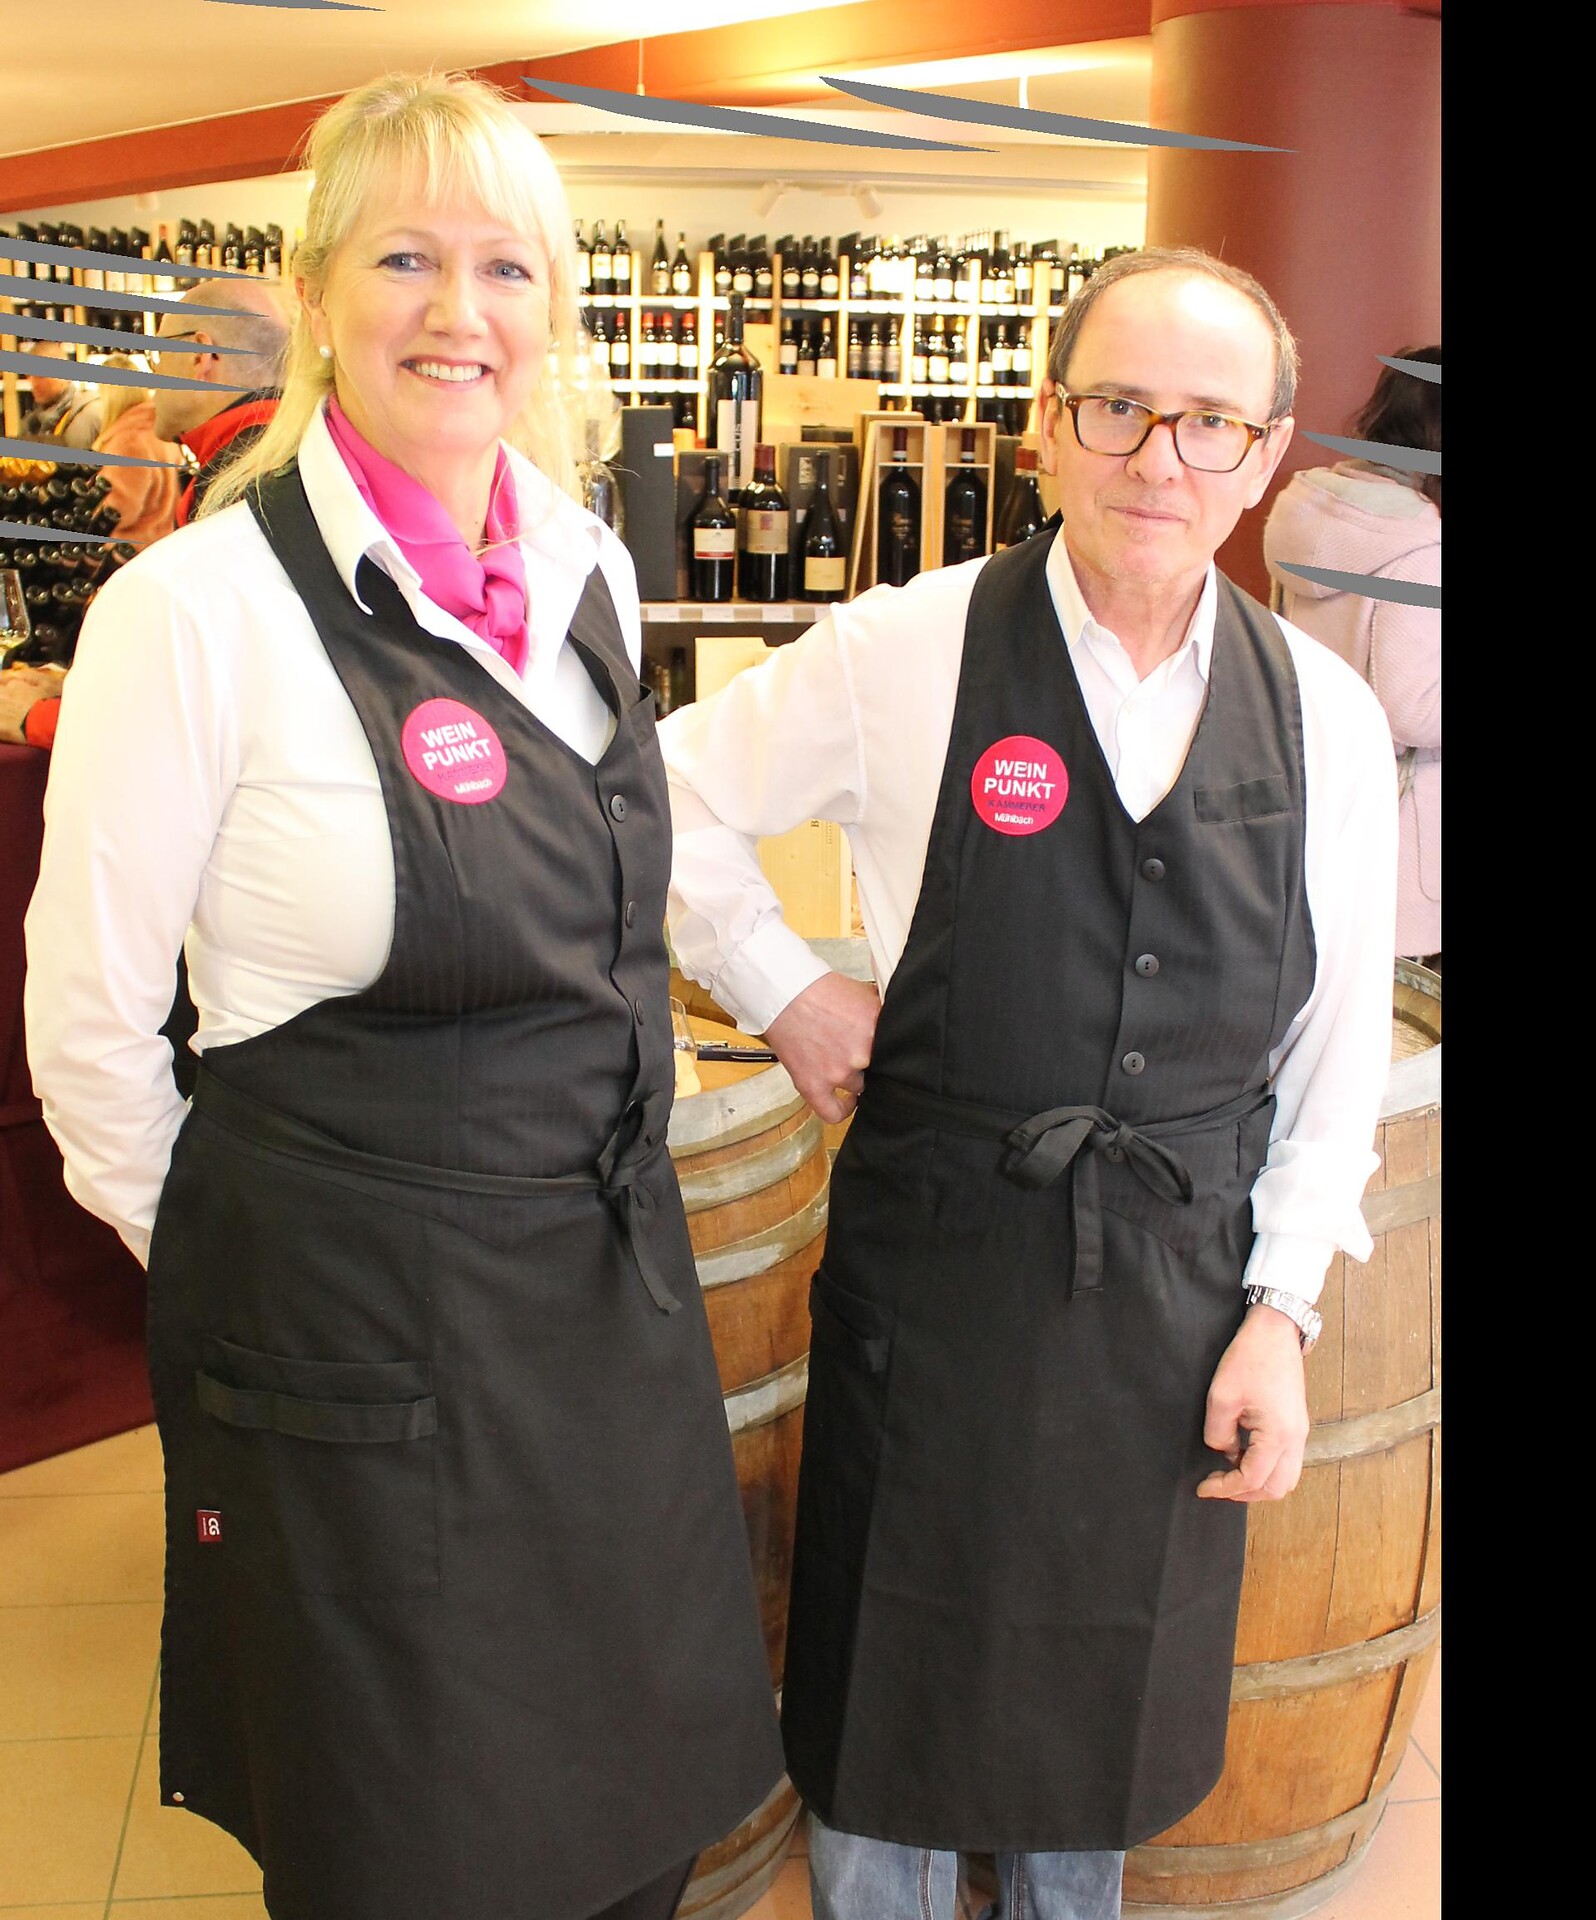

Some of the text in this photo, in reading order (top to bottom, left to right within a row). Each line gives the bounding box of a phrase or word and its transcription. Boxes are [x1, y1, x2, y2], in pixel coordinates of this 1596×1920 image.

[420, 721, 477, 748] WEIN
[422, 738, 491, 771] PUNKT
[995, 759, 1048, 780] WEIN
[983, 777, 1056, 800] PUNKT
